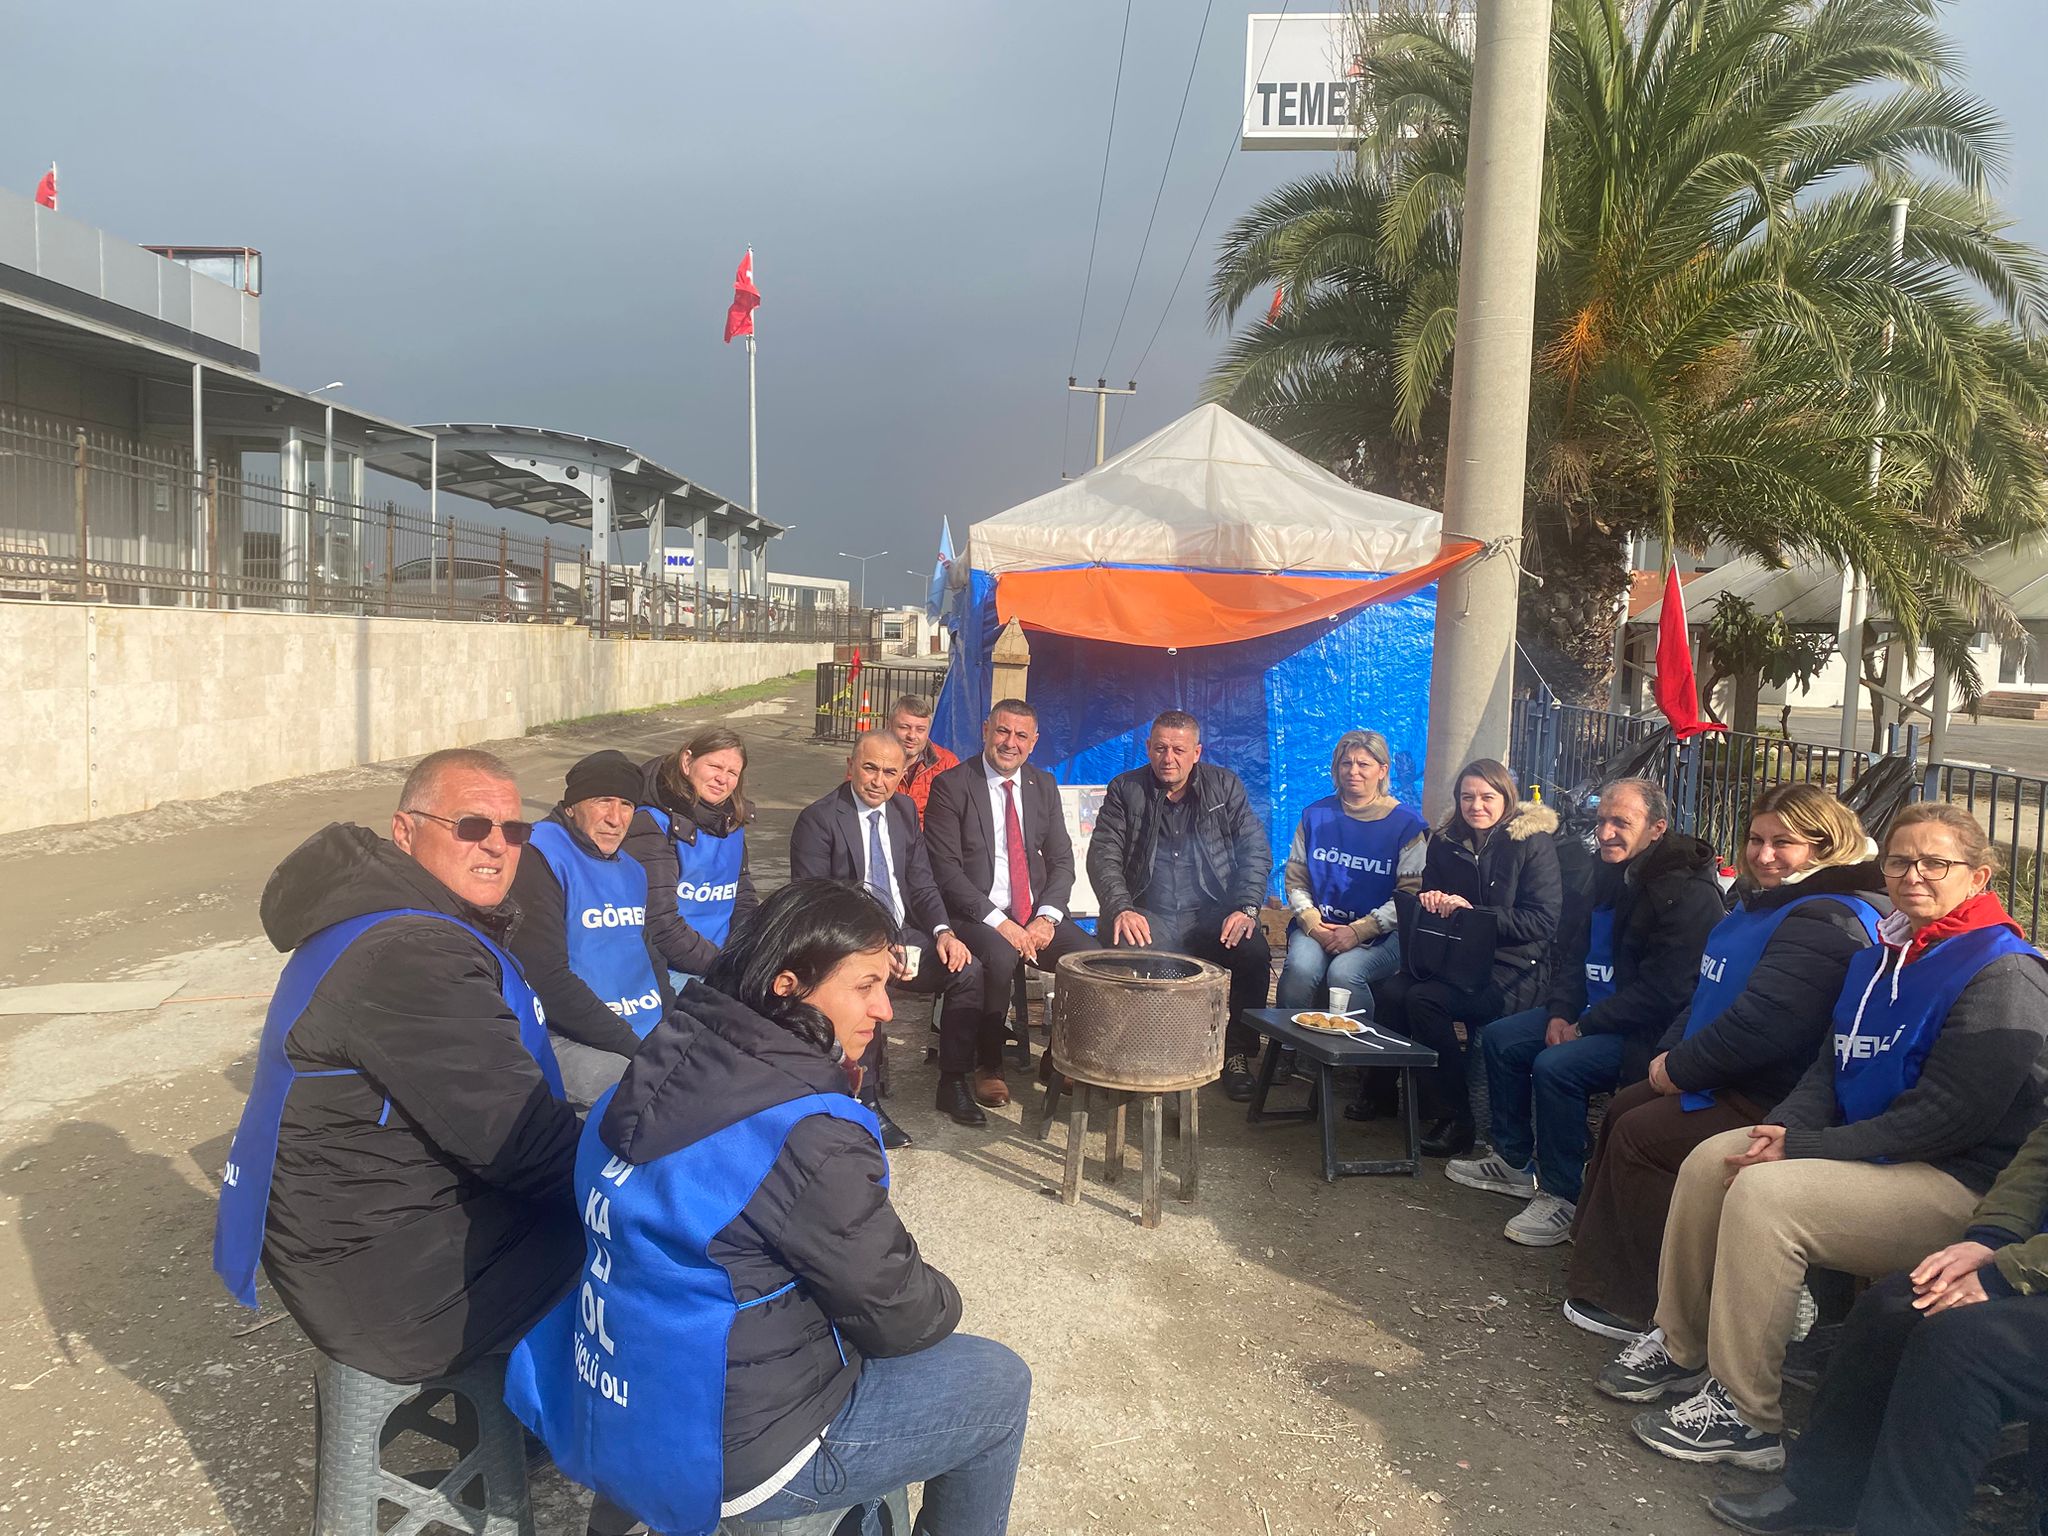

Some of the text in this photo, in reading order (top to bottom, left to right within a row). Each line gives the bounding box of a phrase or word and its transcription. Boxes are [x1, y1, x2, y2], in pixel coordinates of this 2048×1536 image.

[1312, 846, 1392, 875] GÖREVLİ
[584, 1186, 612, 1241] KA
[581, 1280, 615, 1356] OL
[600, 1370, 629, 1409] OL!
